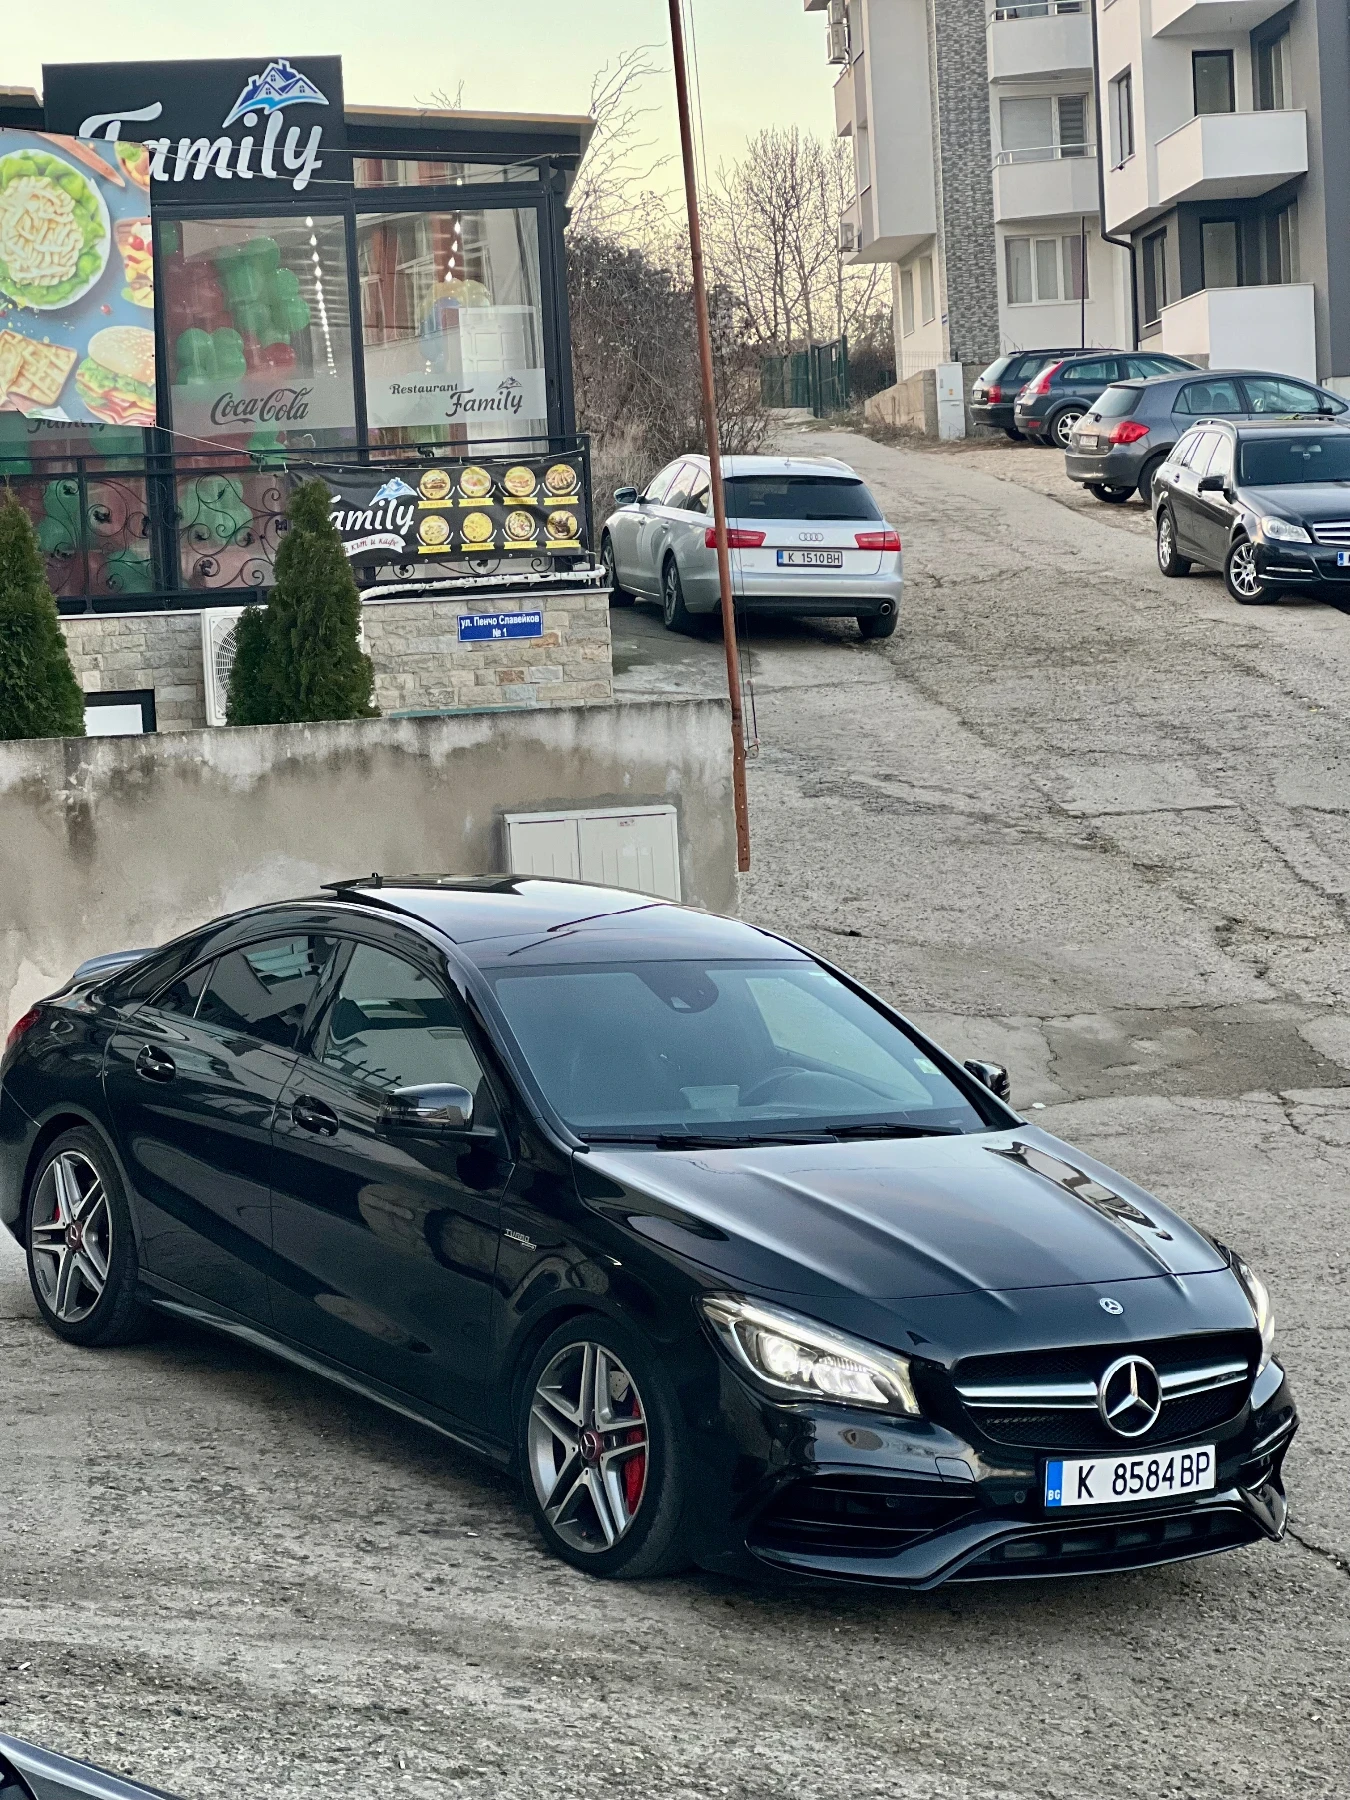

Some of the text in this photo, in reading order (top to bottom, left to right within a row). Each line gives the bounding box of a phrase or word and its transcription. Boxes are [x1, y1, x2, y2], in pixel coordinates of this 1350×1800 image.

[389, 383, 458, 395] Restaurant
[445, 388, 523, 417] Family
[788, 552, 795, 562] K
[461, 614, 540, 629] ул. Пенчо Славейков
[503, 627, 507, 636] 1
[1077, 1465, 1095, 1499] K
[1048, 1490, 1061, 1500] BG
